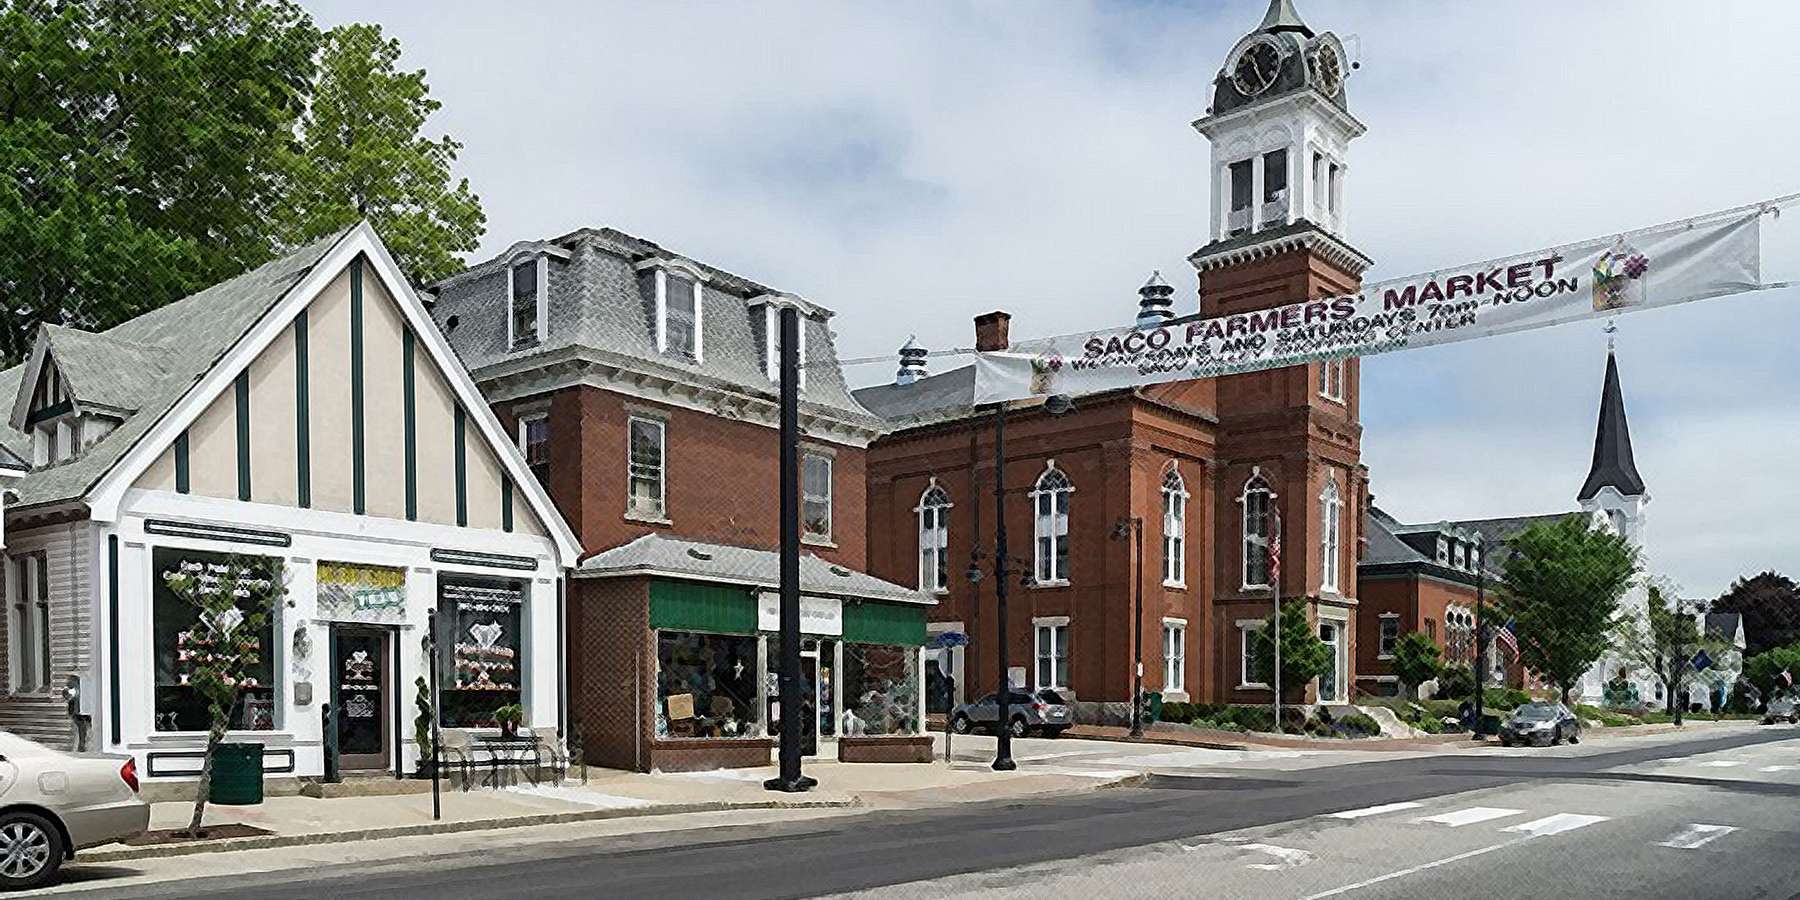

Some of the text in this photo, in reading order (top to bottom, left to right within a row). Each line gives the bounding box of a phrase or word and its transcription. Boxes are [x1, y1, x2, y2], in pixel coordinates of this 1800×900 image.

[1084, 327, 1171, 358] SACO
[1185, 294, 1364, 344] FARMERS'
[1383, 255, 1563, 311] MARKET
[1222, 333, 1267, 352] AND
[1276, 308, 1417, 346] SATURDAYS
